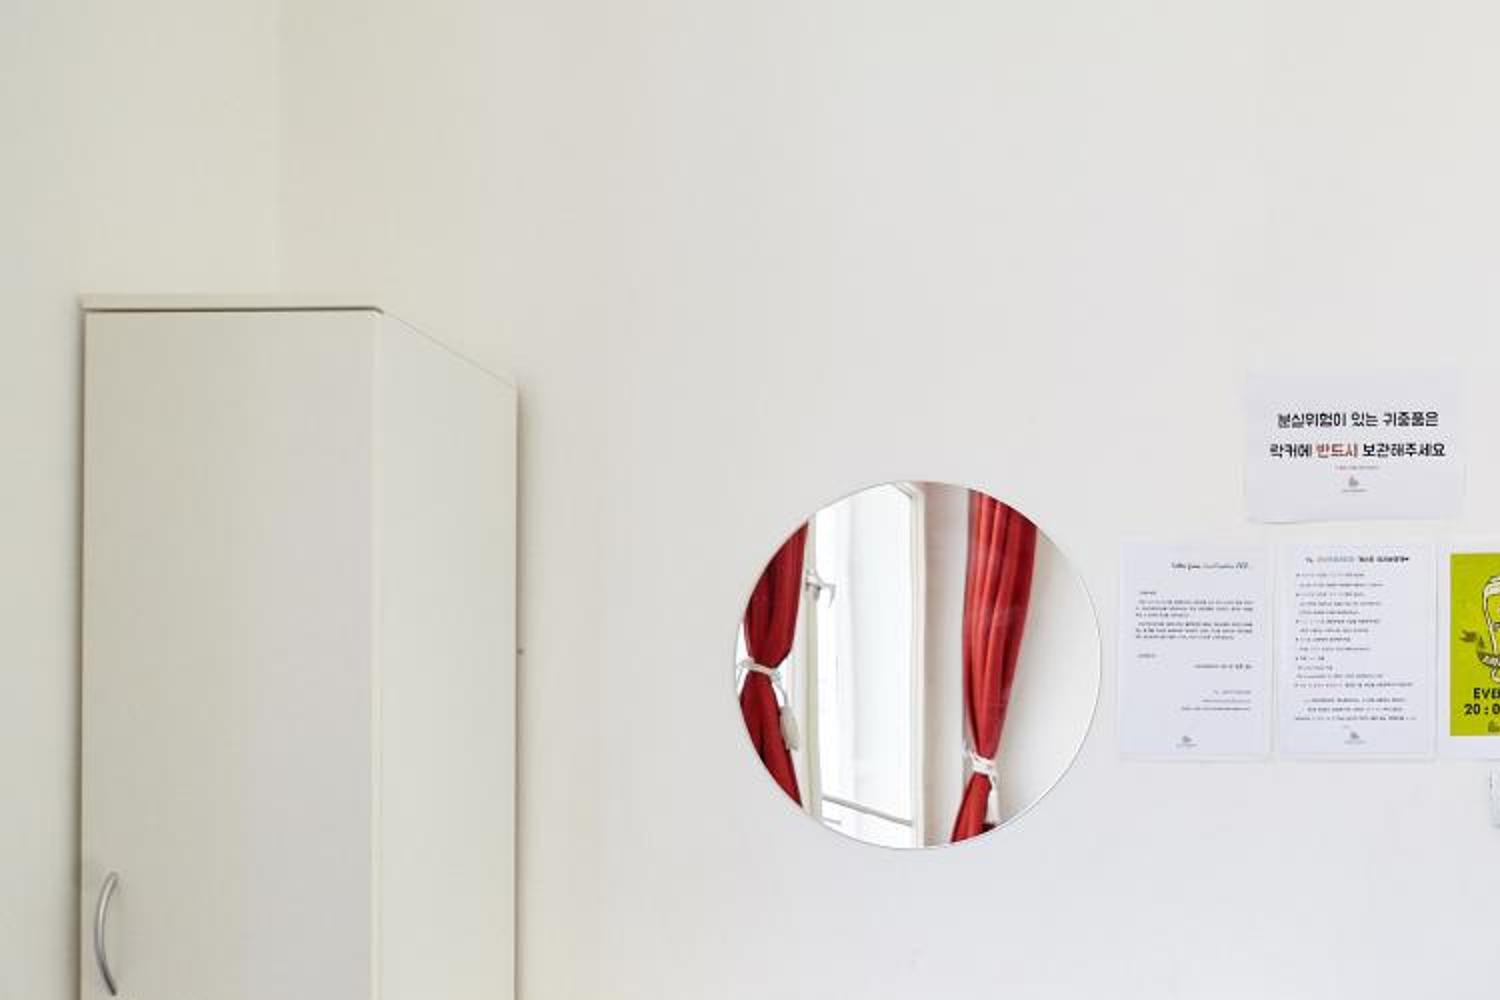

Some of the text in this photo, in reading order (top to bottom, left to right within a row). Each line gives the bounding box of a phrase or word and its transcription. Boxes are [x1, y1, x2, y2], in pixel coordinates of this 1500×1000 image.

[1277, 411, 1439, 428] 분실위험이 있는 귀중품은
[1269, 443, 1446, 458] 락커에 반드시 보관해주세요
